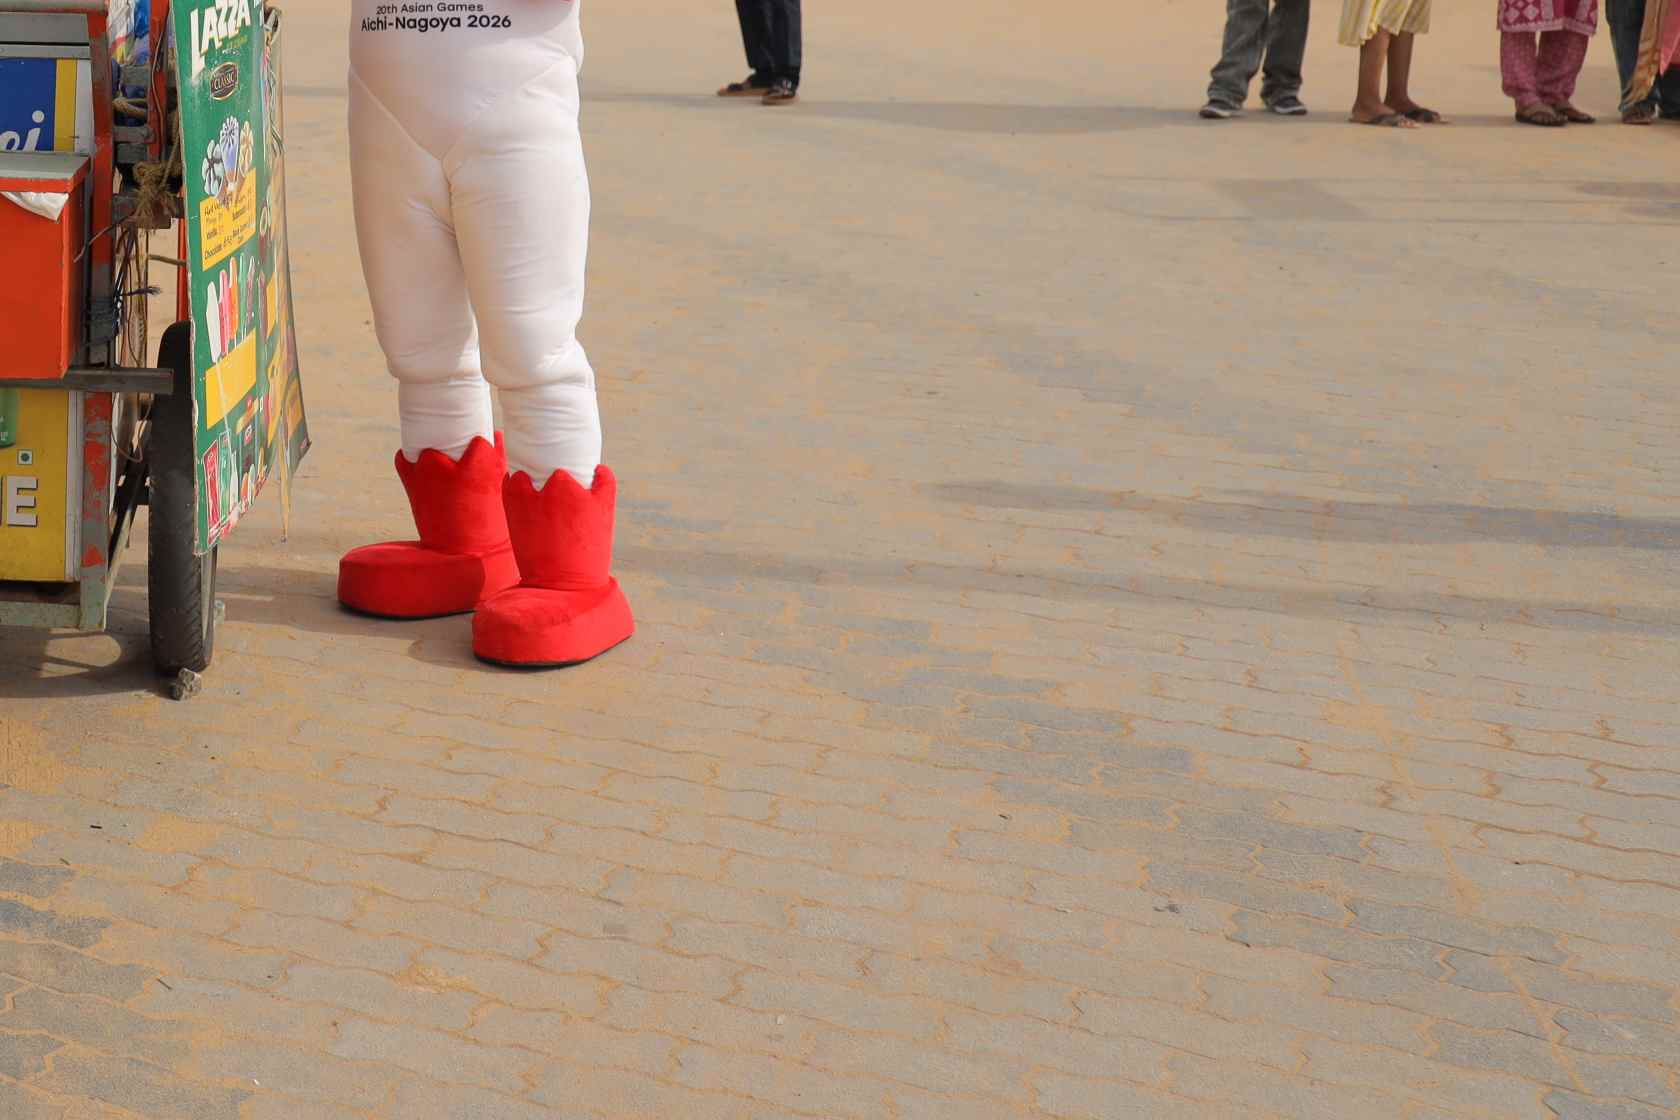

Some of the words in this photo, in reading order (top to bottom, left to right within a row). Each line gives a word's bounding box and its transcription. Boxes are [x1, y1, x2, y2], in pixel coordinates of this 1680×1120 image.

[376, 4, 398, 15] 20th
[401, 2, 433, 13] Asian
[437, 2, 484, 12] Games
[361, 15, 461, 32] Aichi-Nagoya
[467, 14, 512, 28] 2026
